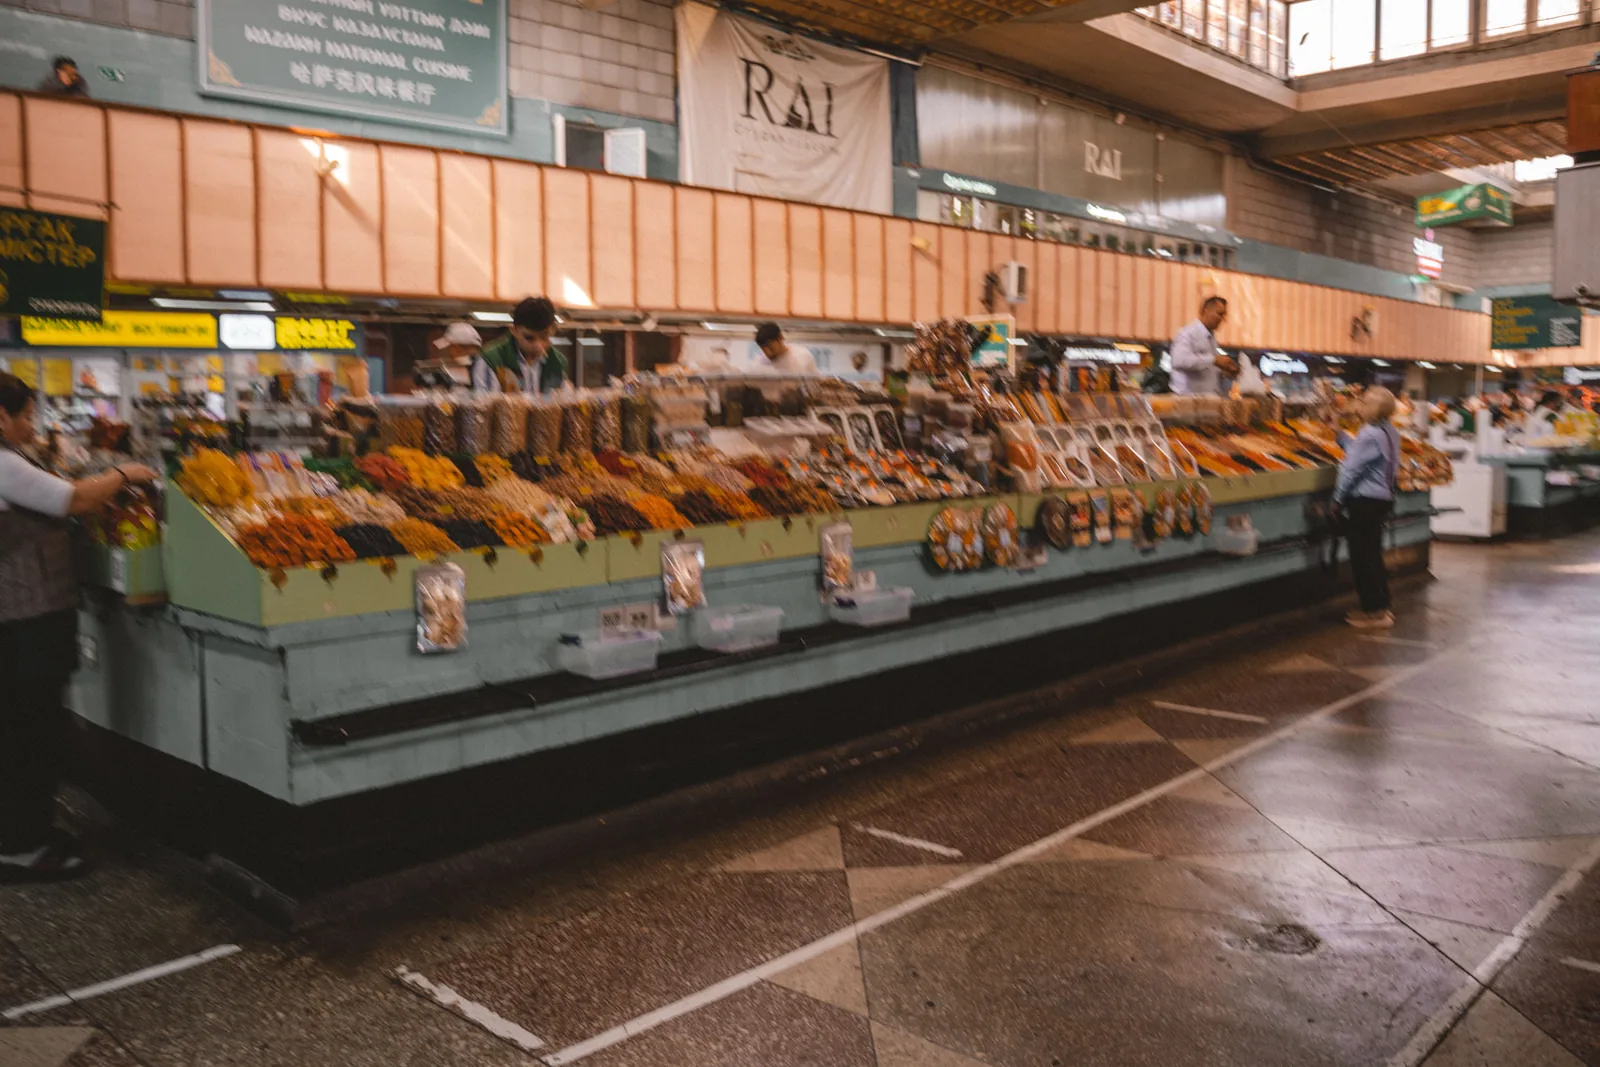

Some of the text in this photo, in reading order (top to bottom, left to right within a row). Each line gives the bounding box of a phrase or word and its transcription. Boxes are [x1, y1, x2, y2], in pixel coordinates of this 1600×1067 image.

[279, 5, 327, 28] ВКУС
[333, 16, 444, 50] КАЗАХСТАНА
[245, 25, 471, 81] KAZAKH NATIONAL CUISINE
[739, 56, 839, 139] RAI
[1084, 140, 1122, 180] RAI
